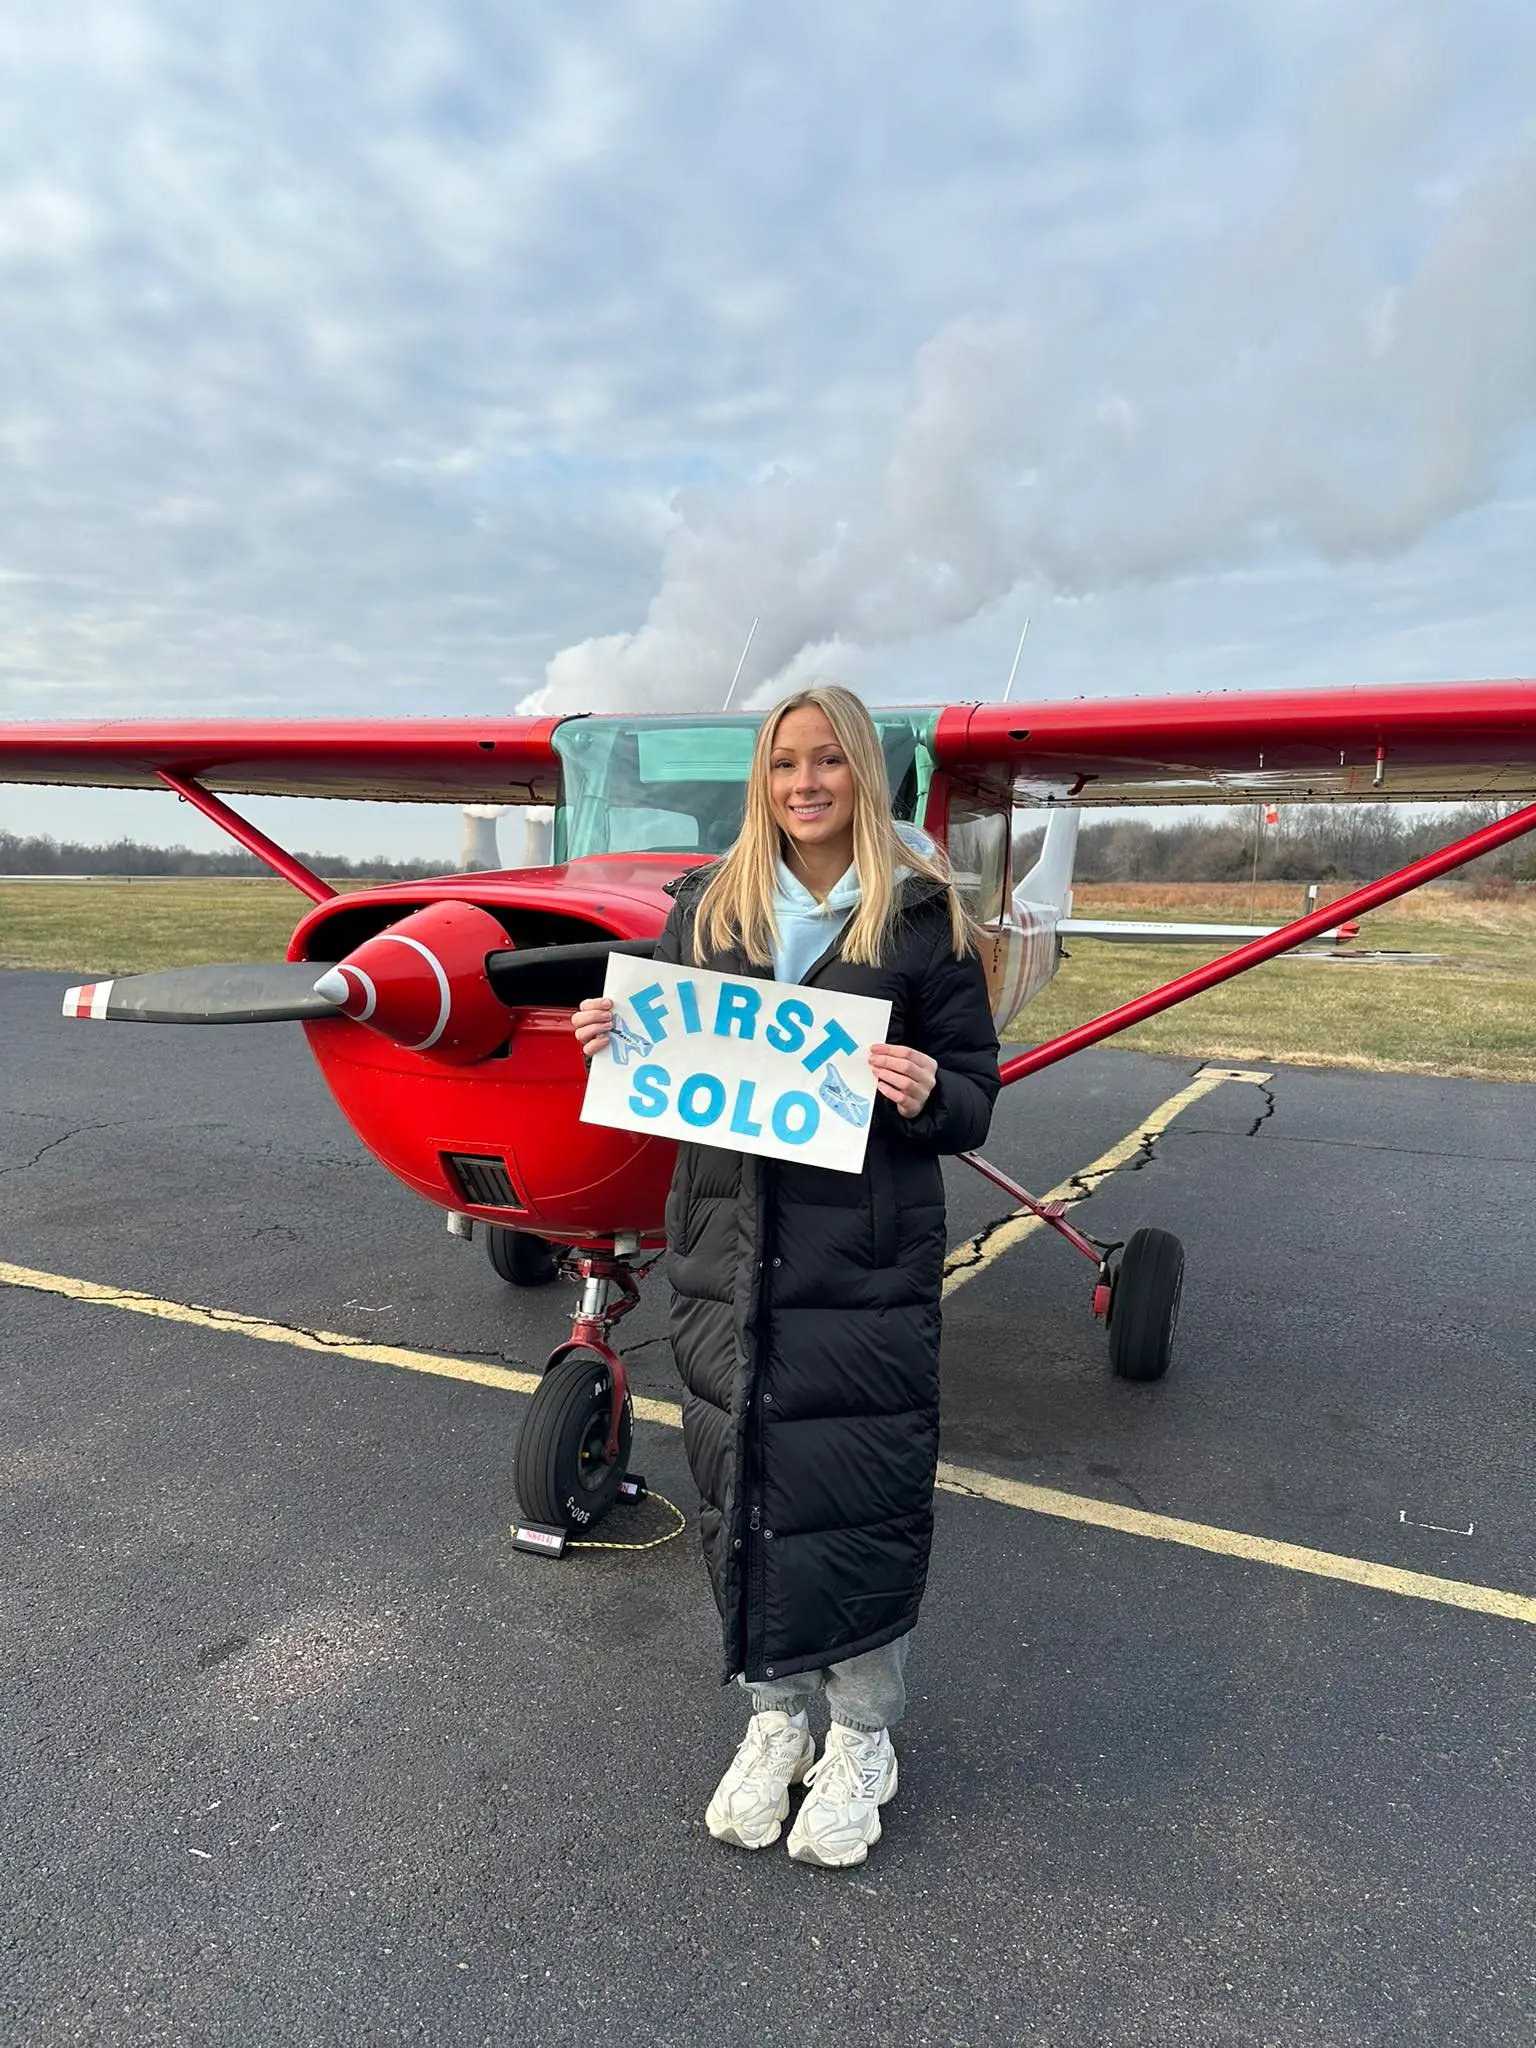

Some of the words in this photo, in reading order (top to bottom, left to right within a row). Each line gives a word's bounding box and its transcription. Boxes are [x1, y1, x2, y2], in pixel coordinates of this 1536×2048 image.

[628, 980, 859, 1074] FIRST
[628, 1064, 820, 1145] SOLO
[566, 1496, 590, 1524] 500-5
